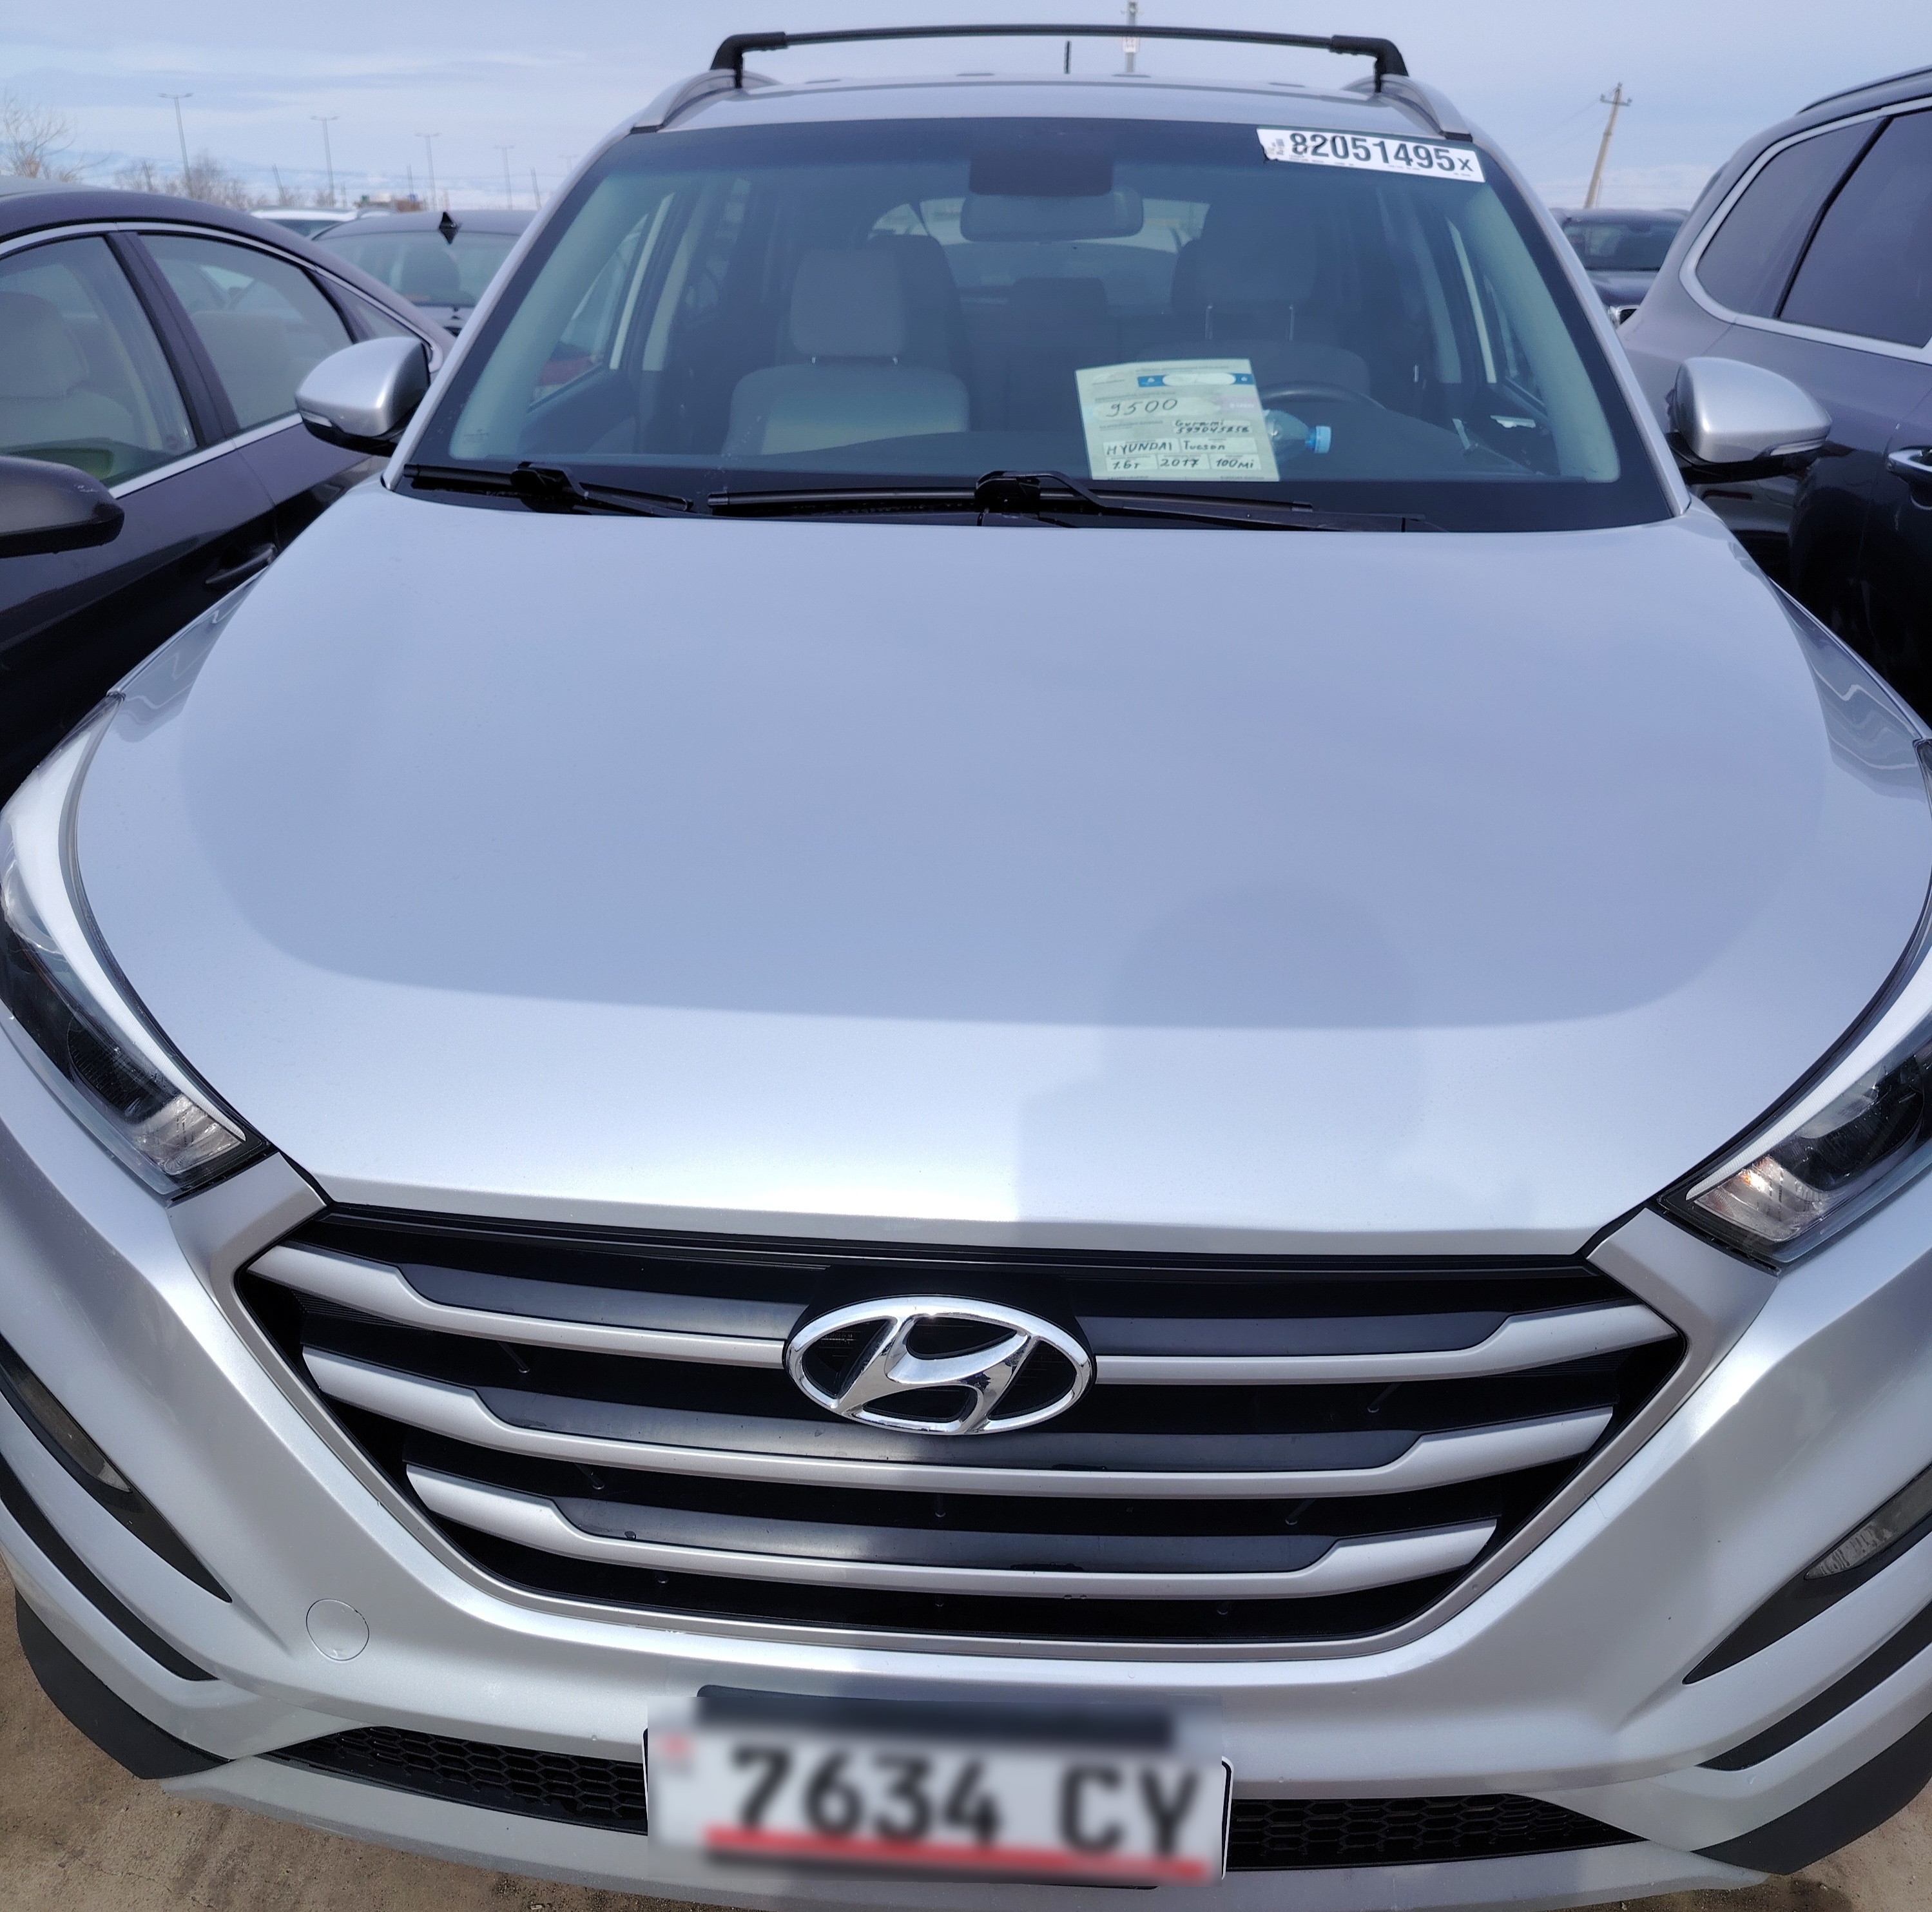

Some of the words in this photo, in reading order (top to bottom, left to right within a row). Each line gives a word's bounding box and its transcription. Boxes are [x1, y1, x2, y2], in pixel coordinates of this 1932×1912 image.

[1105, 398, 1178, 418] 9500
[1106, 442, 1173, 455] HYUNDAI
[1184, 441, 1226, 450] Tucson
[1159, 458, 1199, 467] 2017
